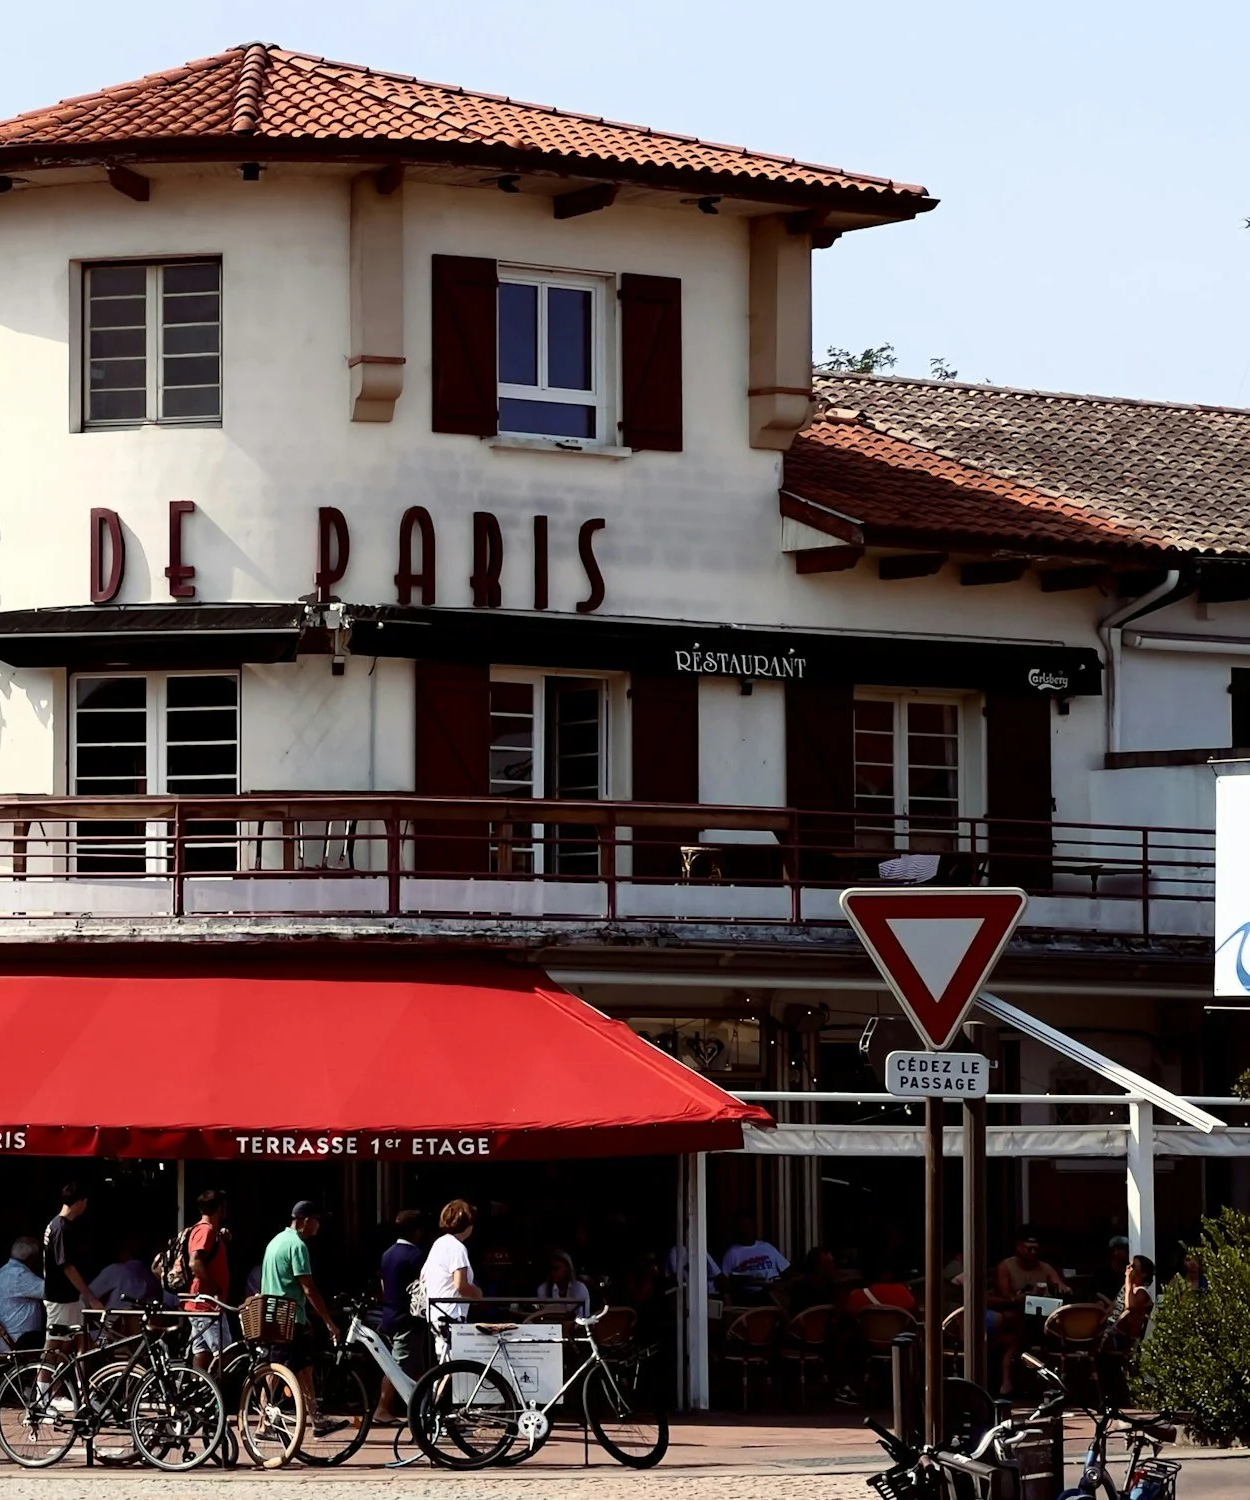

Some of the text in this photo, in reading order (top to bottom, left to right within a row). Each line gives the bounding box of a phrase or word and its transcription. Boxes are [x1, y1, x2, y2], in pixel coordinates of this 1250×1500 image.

[90, 500, 196, 604] DE
[314, 505, 606, 613] PARIS
[675, 650, 807, 678] RESTAURANT
[1028, 668, 1069, 690] Carlsberg
[897, 1056, 980, 1074] CÉDEZ LE
[900, 1075, 976, 1091] PASSAGE
[235, 1136, 491, 1156] TERRASSE 1er ETAGE
